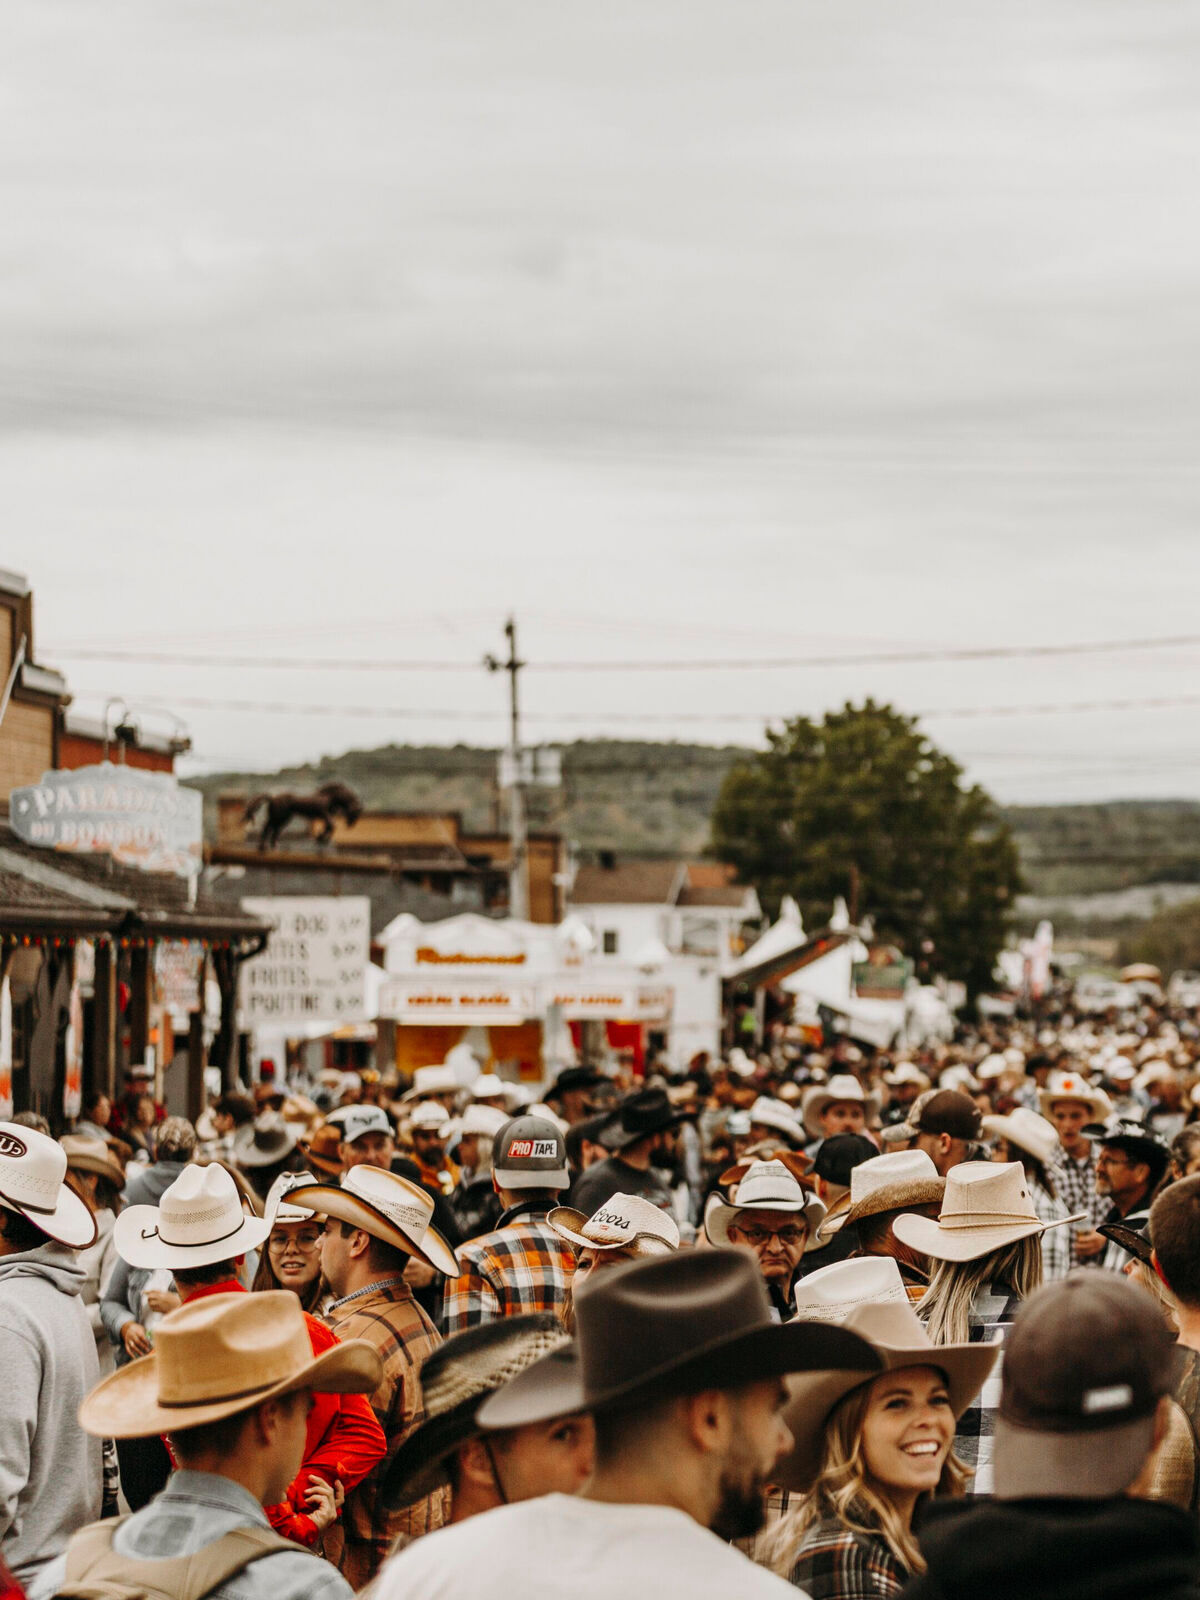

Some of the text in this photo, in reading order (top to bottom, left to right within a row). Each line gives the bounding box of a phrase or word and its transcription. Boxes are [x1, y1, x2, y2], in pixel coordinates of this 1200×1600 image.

[510, 1141, 554, 1156] PRO TAPE
[592, 1208, 631, 1230] Coors
